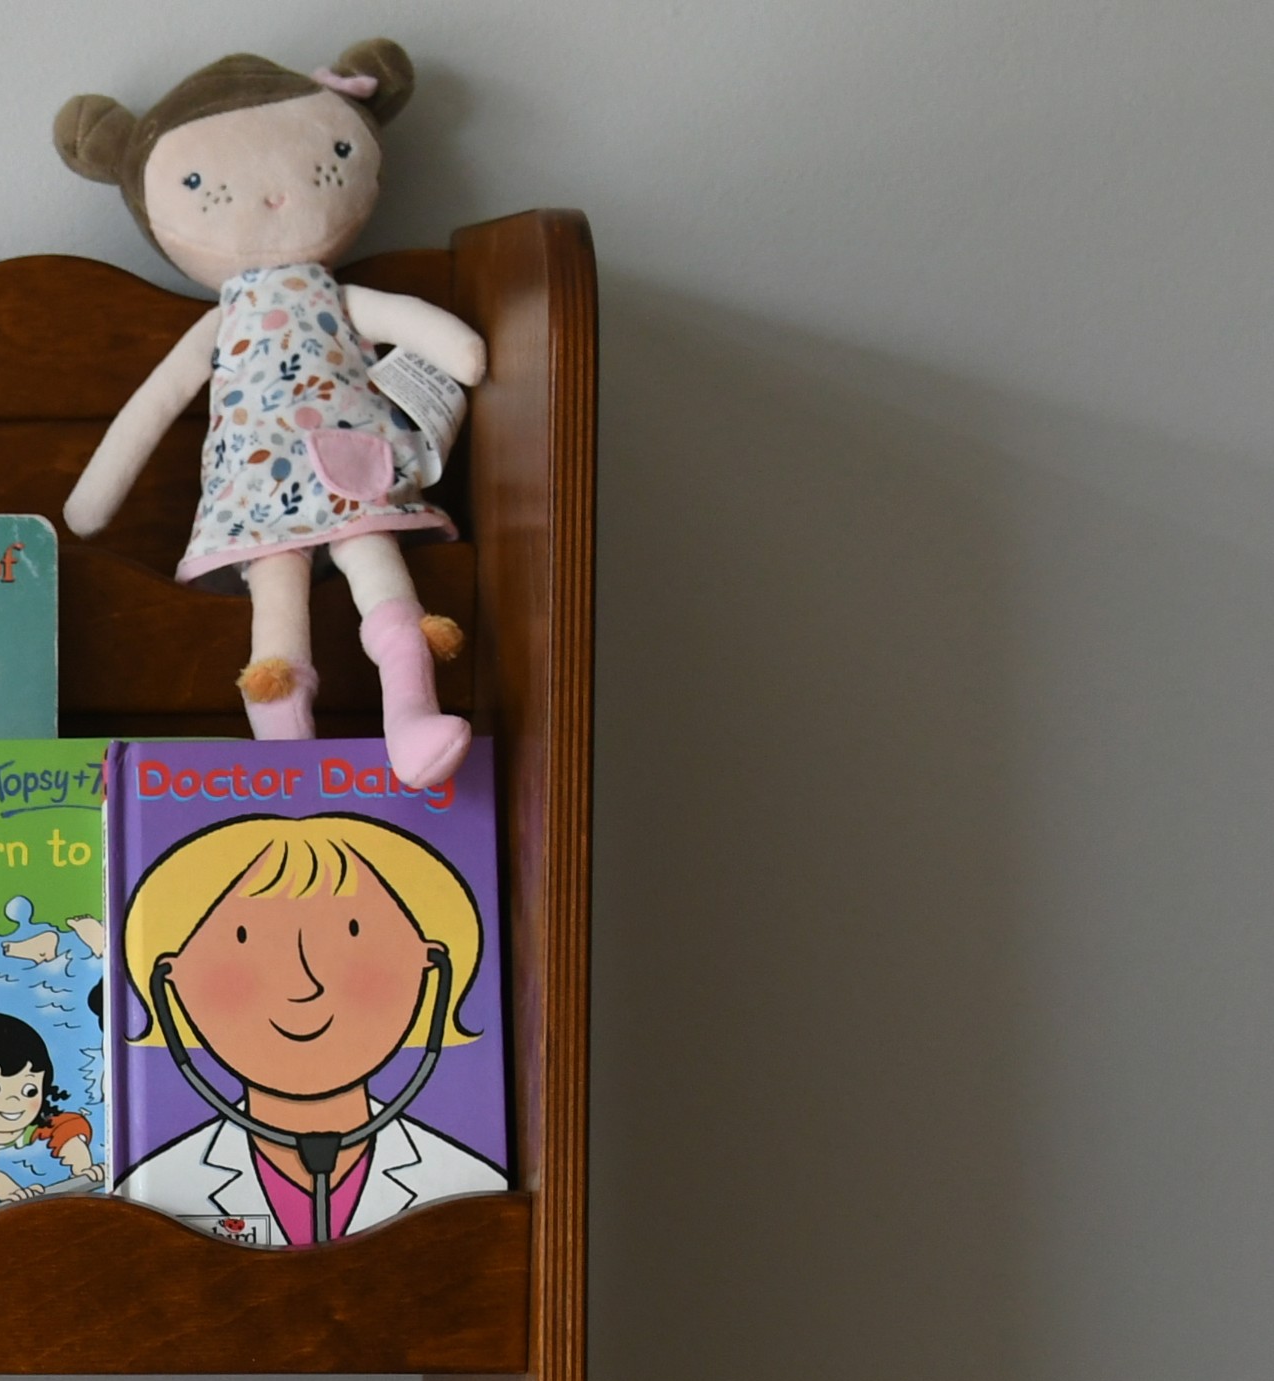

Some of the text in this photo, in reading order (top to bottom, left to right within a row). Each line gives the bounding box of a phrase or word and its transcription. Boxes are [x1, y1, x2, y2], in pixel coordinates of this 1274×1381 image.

[135, 757, 456, 814] Doctor Daiy
[49, 828, 92, 869] to
